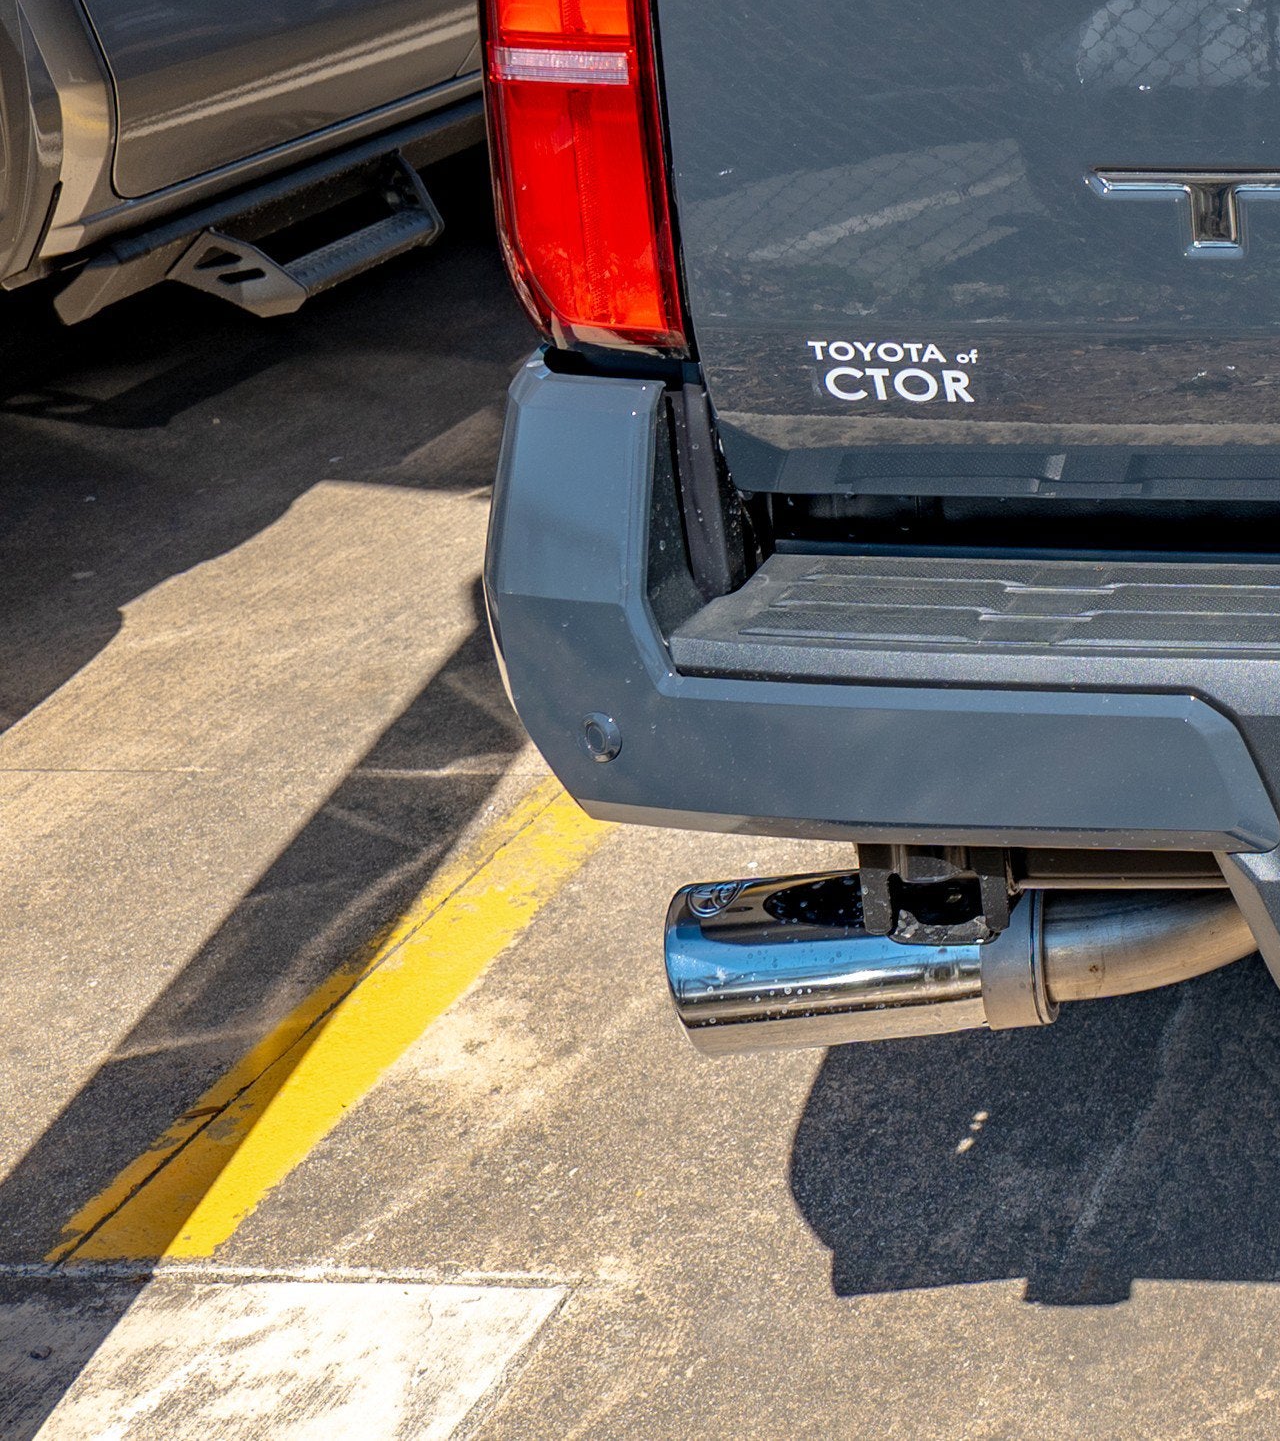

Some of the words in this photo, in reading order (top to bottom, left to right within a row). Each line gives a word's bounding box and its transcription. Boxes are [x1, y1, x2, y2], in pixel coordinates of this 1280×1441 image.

[806, 340, 947, 363] TOYOTA
[955, 348, 979, 364] of
[824, 366, 976, 403] CTOR
